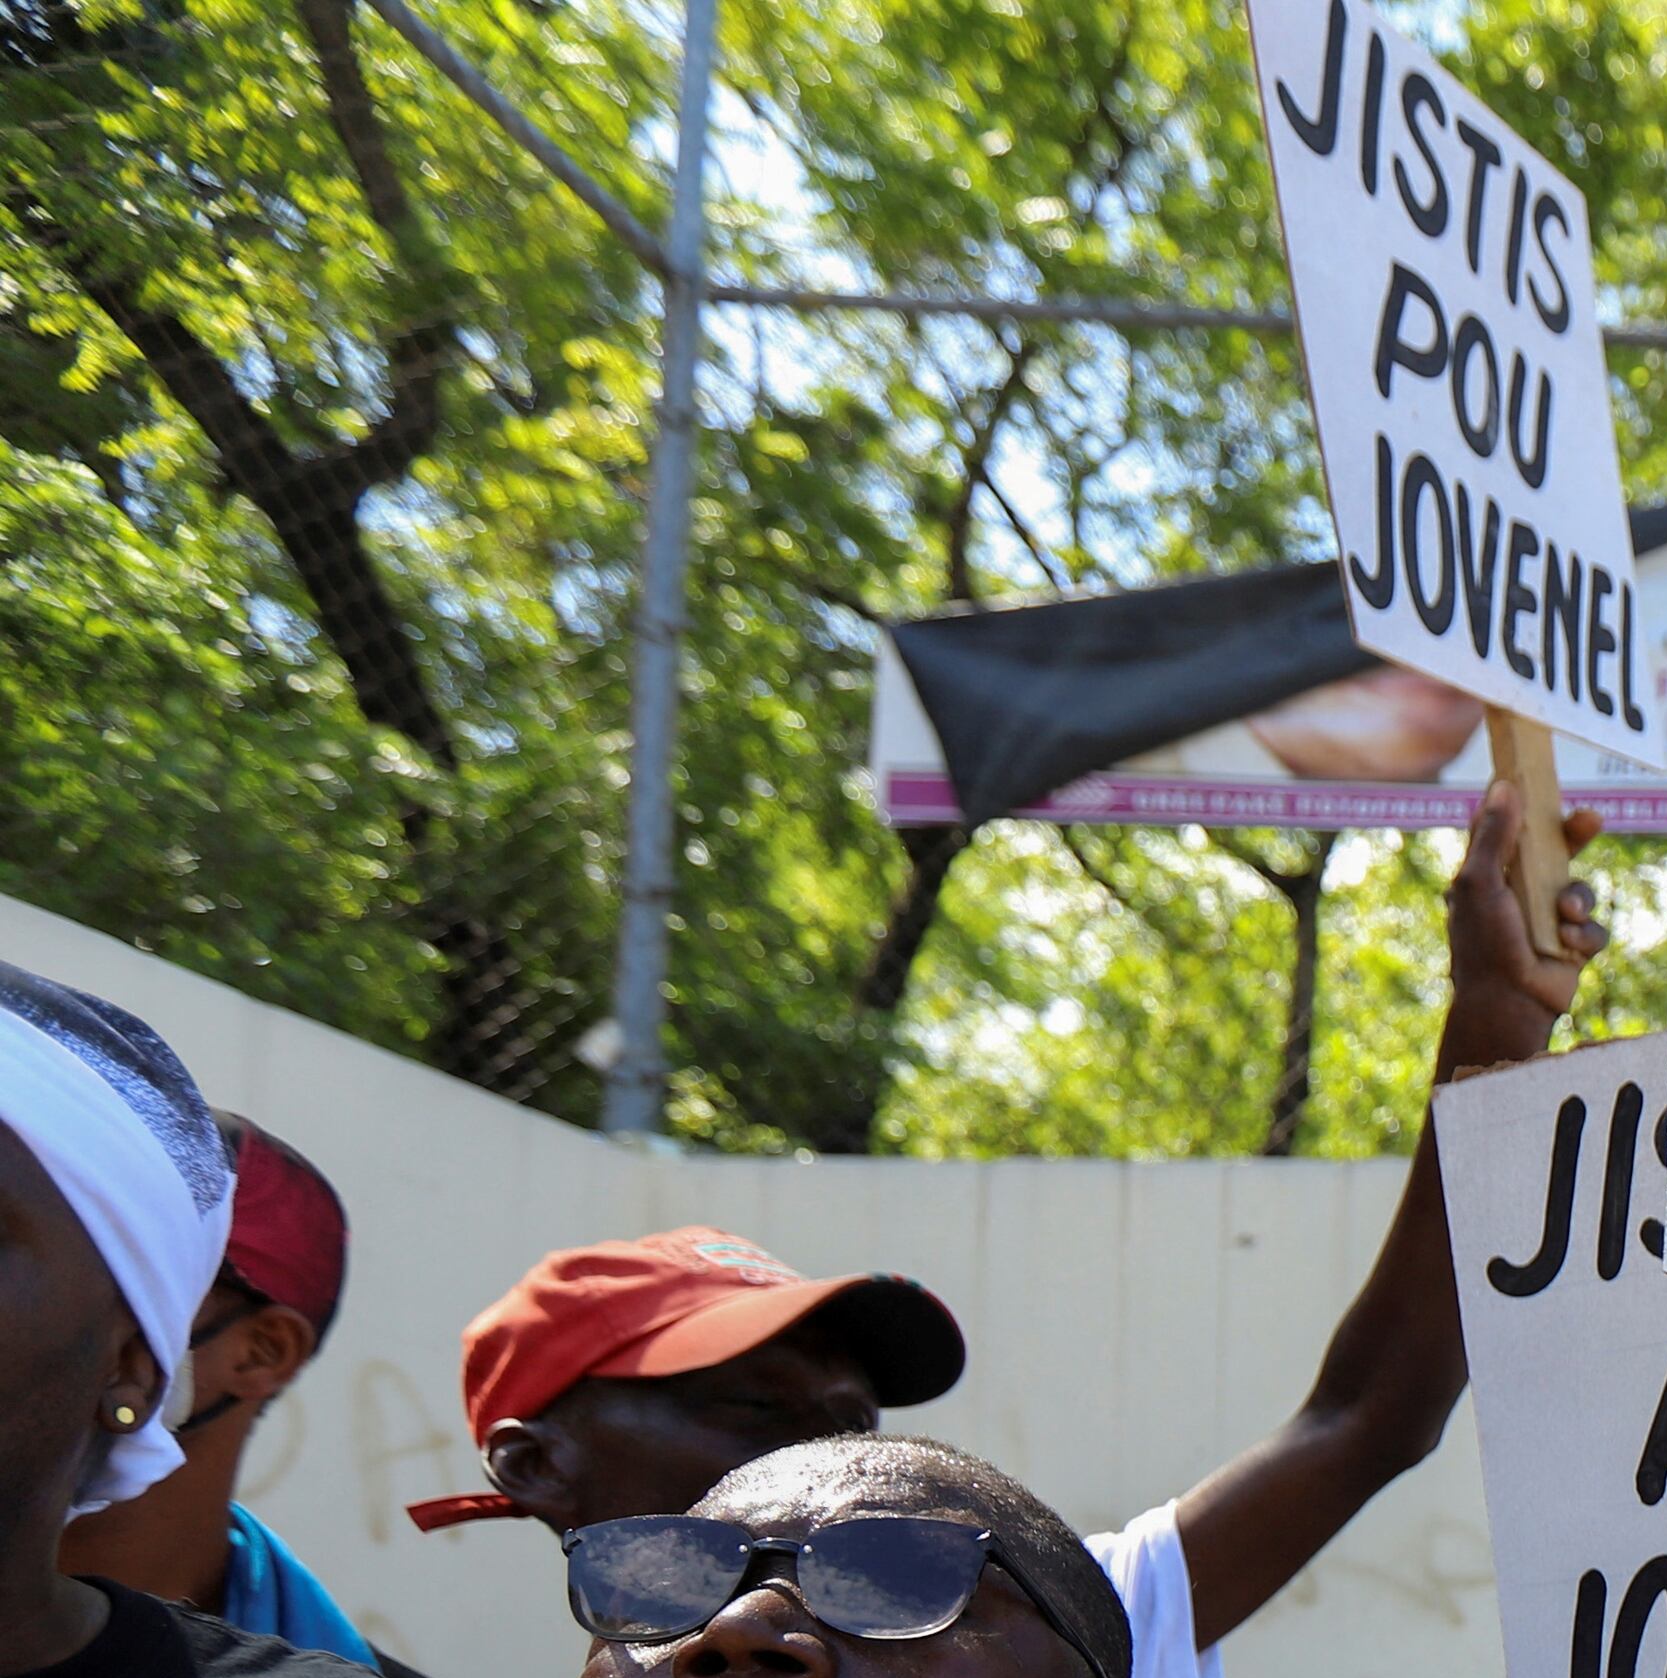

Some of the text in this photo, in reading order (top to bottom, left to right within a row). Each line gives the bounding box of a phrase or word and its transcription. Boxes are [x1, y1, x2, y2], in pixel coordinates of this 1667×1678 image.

[1276, 0, 1572, 335] JISTIS
[1376, 259, 1552, 491] POU
[1350, 435, 1645, 733] JOVENEL
